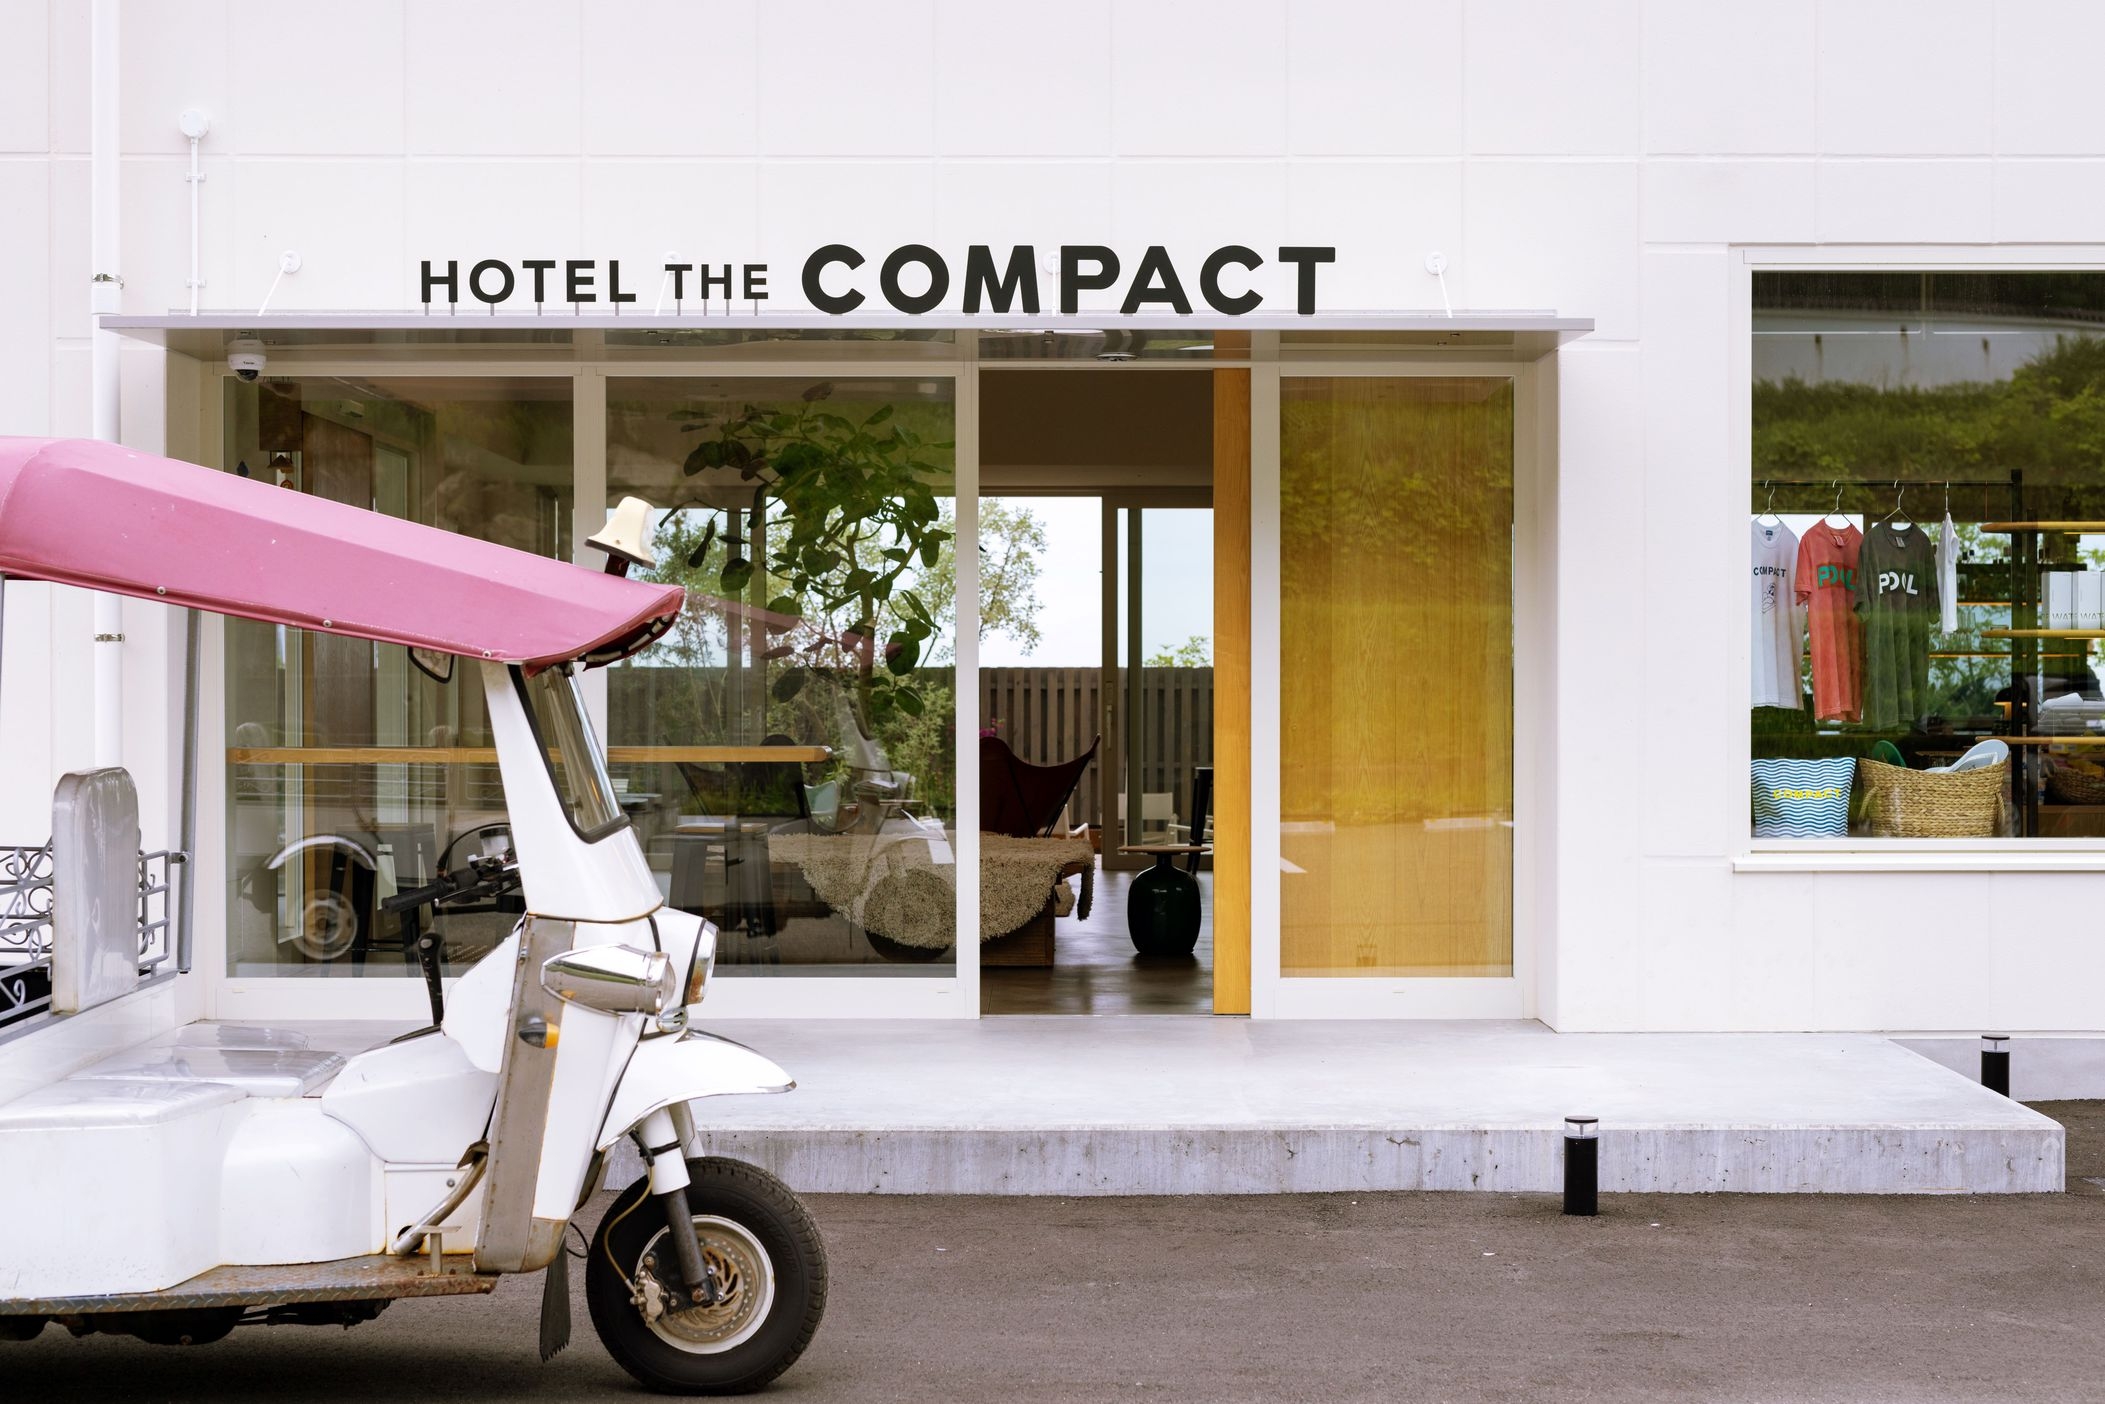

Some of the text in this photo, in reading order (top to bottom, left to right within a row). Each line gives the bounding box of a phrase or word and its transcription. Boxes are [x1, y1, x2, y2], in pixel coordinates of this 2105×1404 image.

[421, 244, 1336, 315] HOTEL THE COMPACT
[1773, 787, 1841, 800] COMPACT
